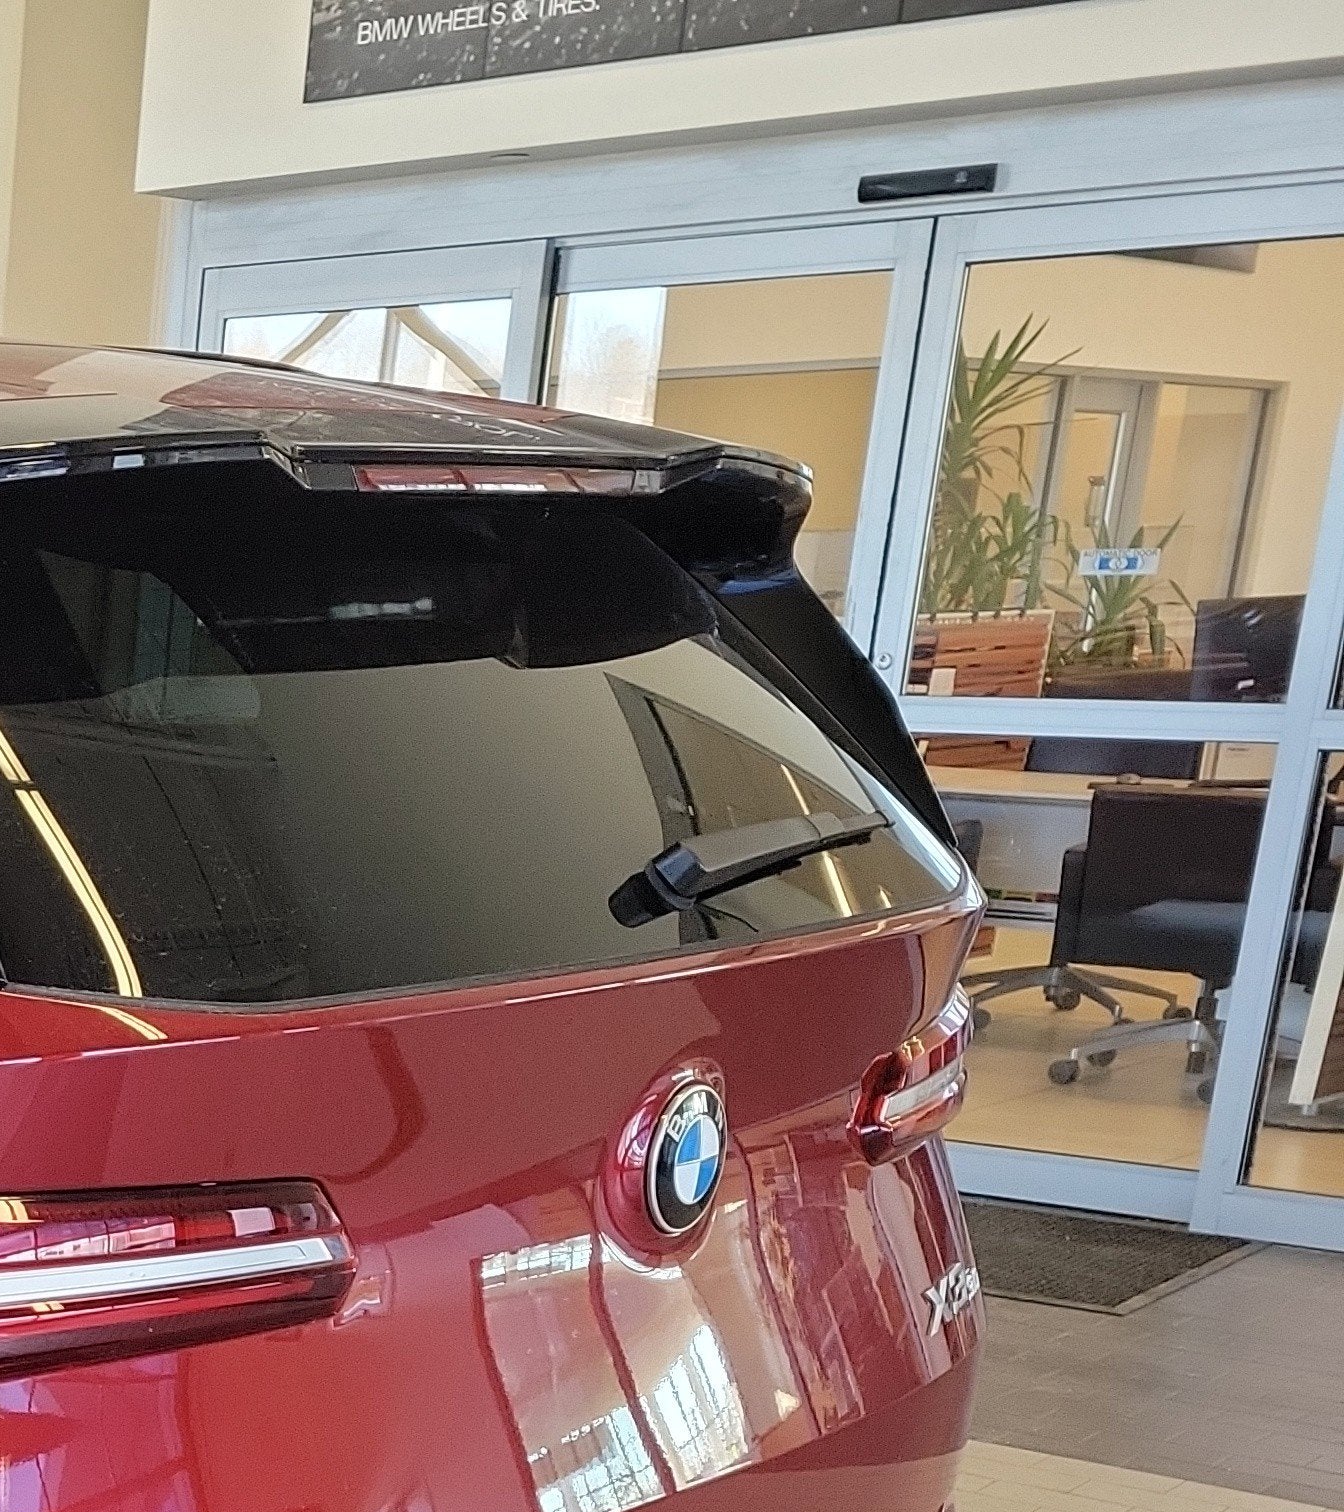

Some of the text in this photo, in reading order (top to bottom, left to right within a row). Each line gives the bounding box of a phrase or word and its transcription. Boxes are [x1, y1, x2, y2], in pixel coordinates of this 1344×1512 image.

[356, 15, 413, 45] BMW
[417, 2, 507, 36] WHEELS
[511, 0, 528, 23] &
[667, 1091, 723, 1142] BMW
